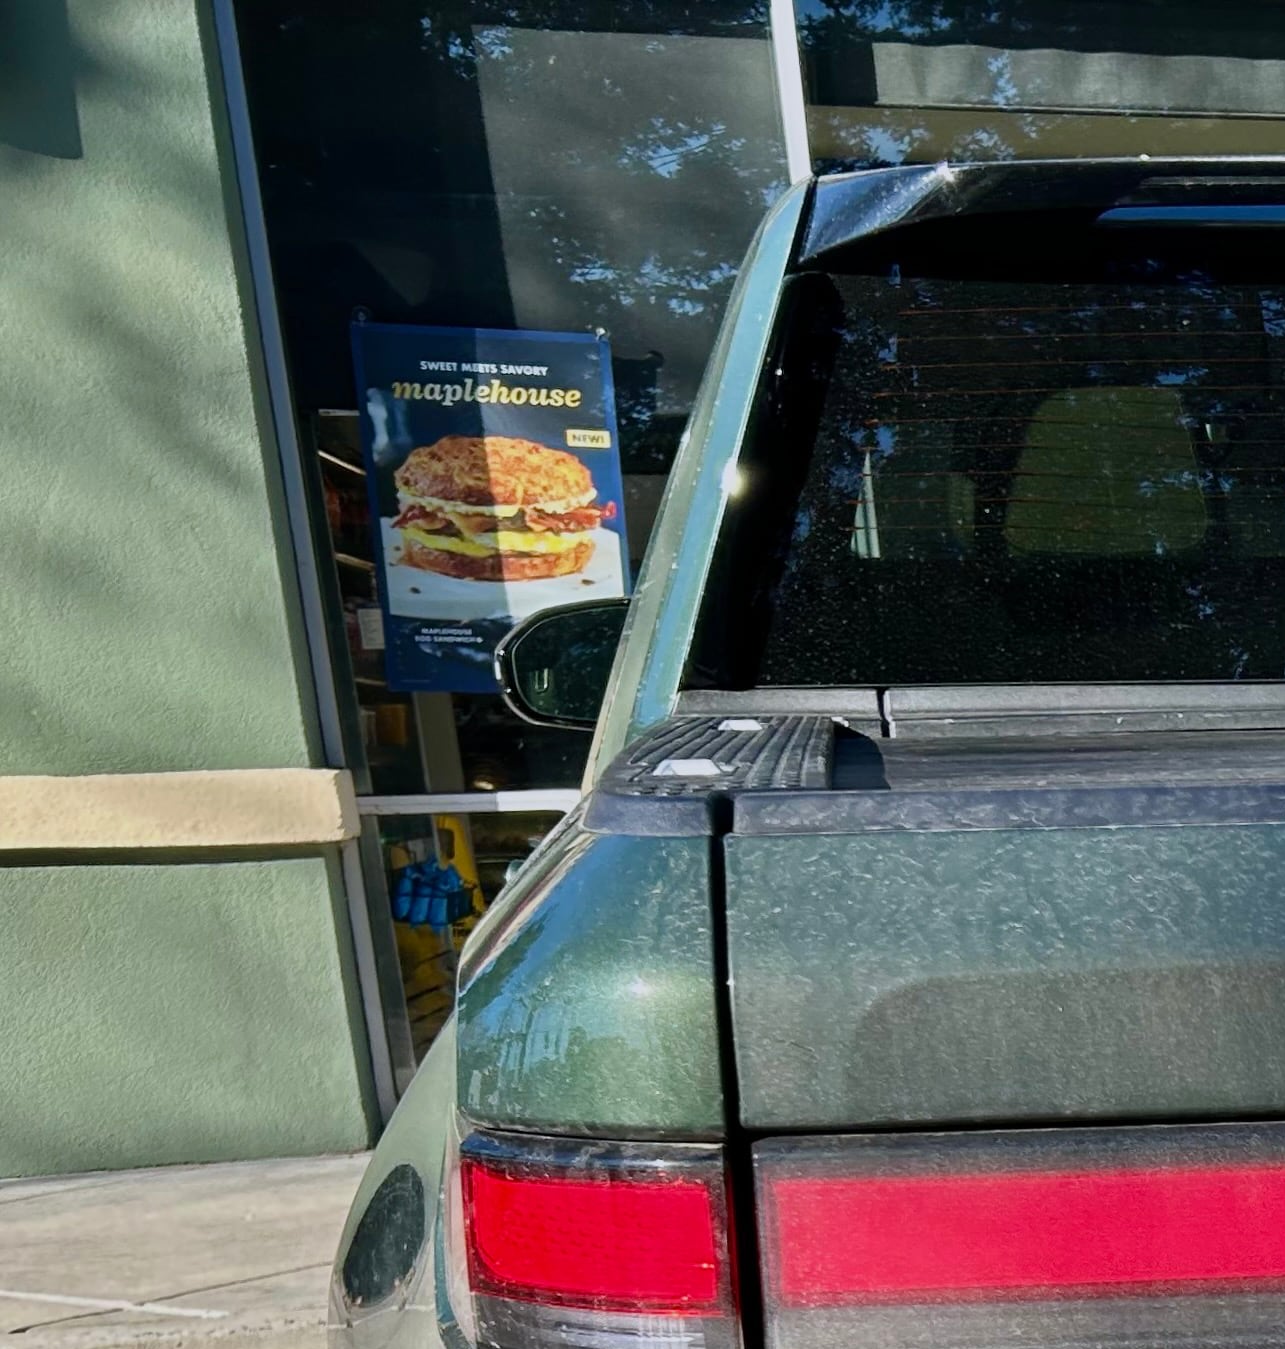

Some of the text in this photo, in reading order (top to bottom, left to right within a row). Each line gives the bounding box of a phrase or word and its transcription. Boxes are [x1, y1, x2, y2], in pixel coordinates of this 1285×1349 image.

[420, 361, 549, 376] SWEET MEETS SAVORY
[392, 378, 582, 407] maplehouse
